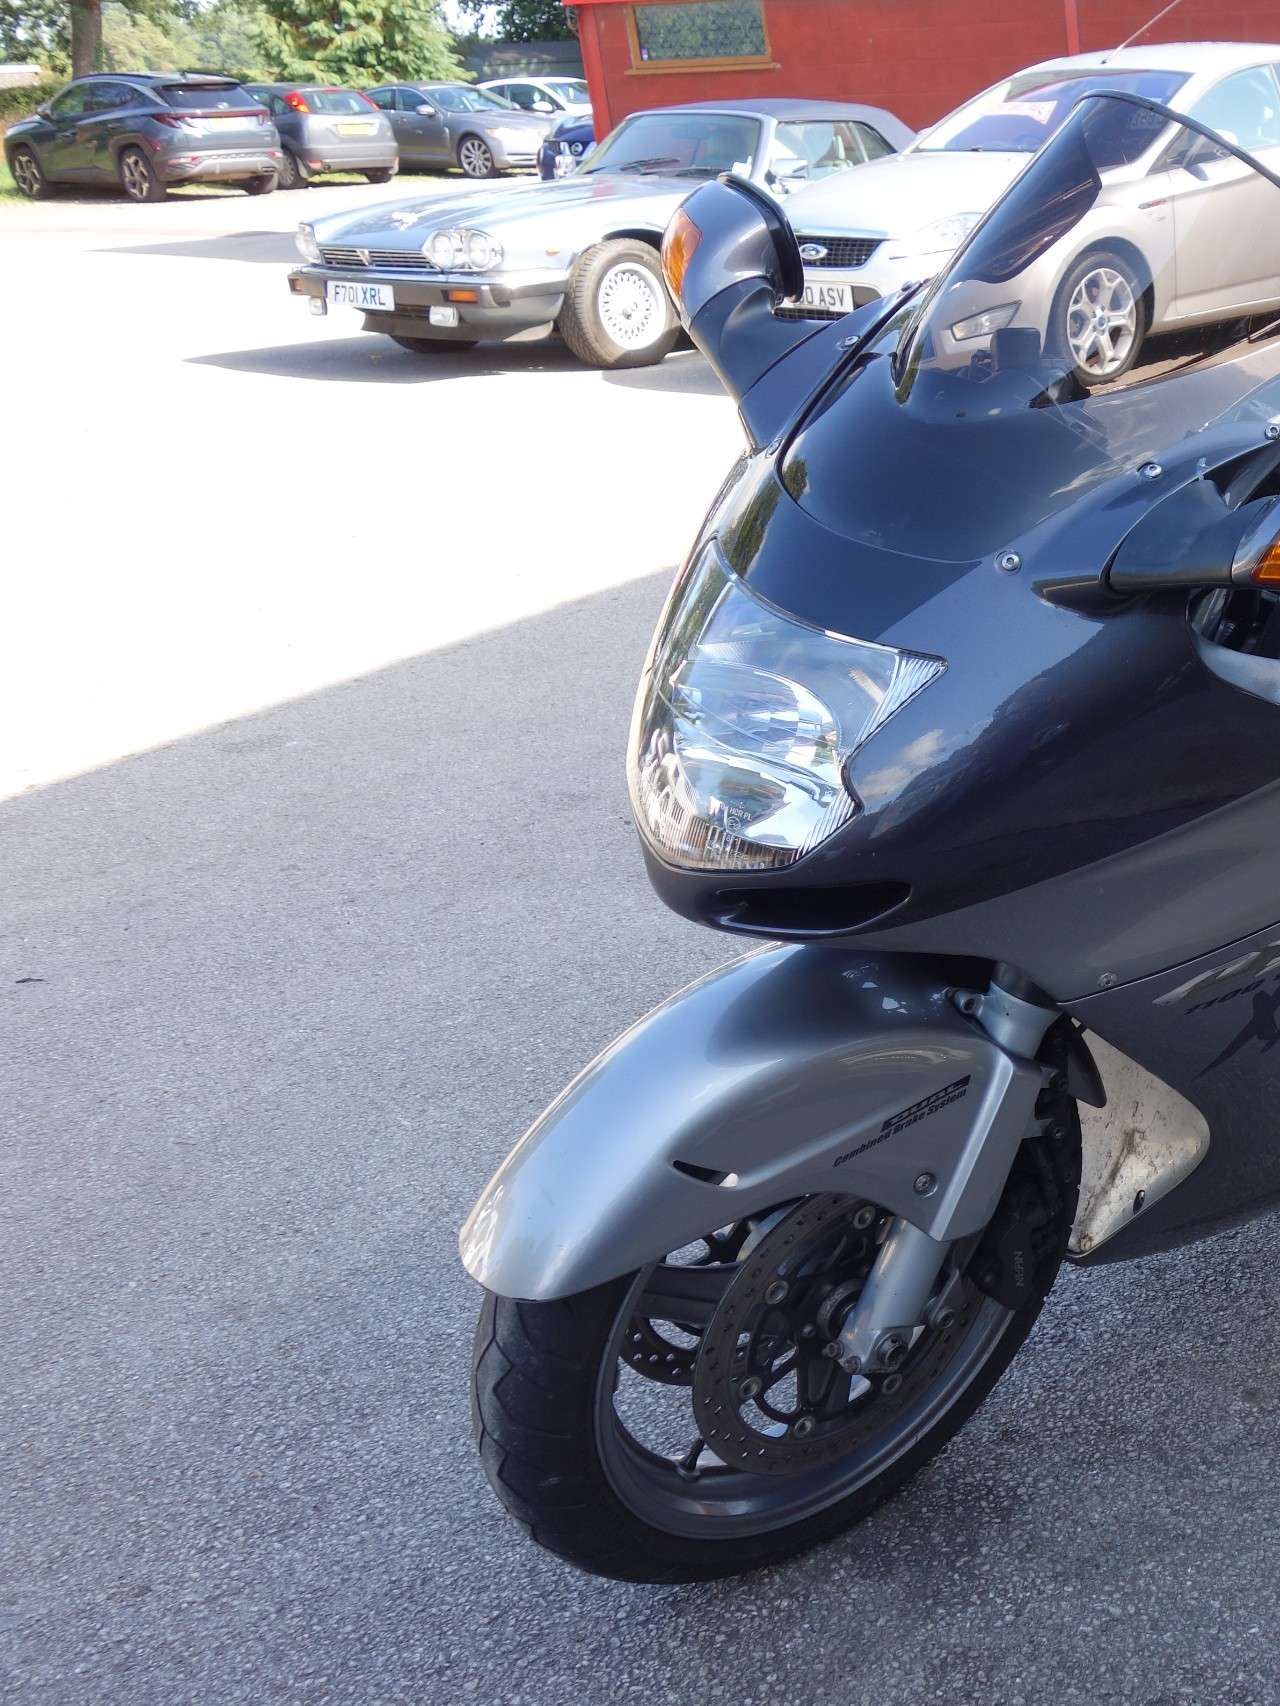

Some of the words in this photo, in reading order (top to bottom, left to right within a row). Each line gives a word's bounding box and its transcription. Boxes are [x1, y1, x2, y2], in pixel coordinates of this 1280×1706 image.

[334, 284, 358, 304] F701
[361, 286, 386, 306] XRL
[819, 287, 844, 307] ASV
[833, 1129, 893, 1168] Combined
[891, 1111, 926, 1136] Brake
[926, 1087, 967, 1117] System
